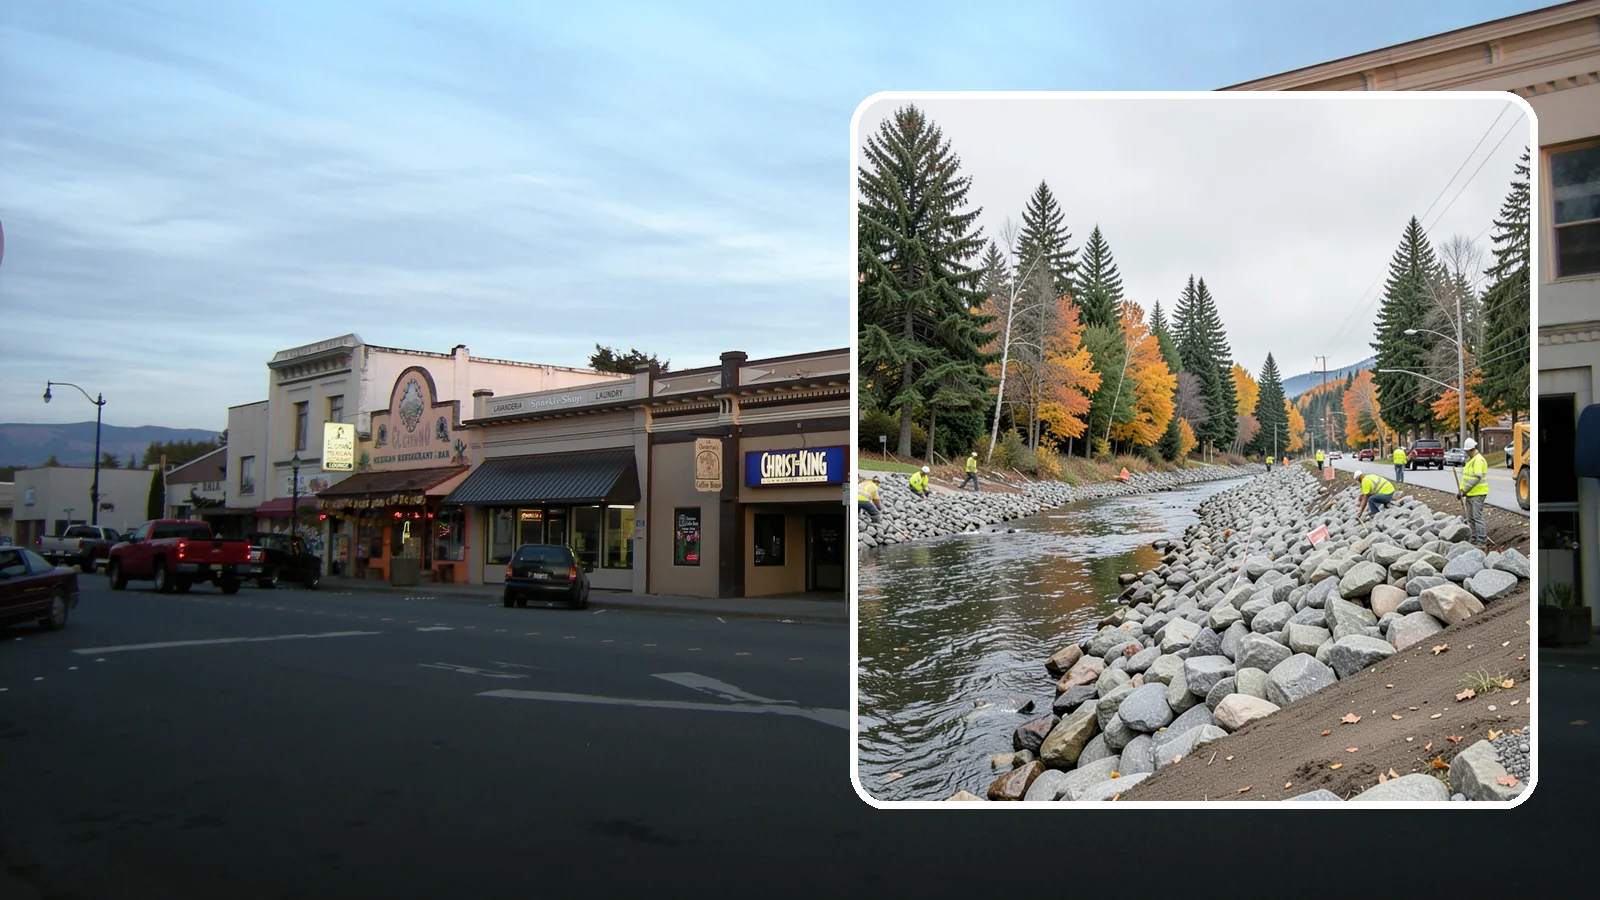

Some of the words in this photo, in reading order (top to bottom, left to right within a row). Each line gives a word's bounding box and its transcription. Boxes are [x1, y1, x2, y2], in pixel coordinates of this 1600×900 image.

[561, 394, 582, 404] Shop
[595, 389, 623, 400] LAUNDRY
[493, 402, 522, 412] LAVANDERIA
[374, 455, 396, 463] MEXICAN
[397, 451, 433, 462] RESTAURANT
[437, 450, 450, 459] BAR
[761, 452, 797, 477] CHRIST
[799, 450, 827, 476] KING
